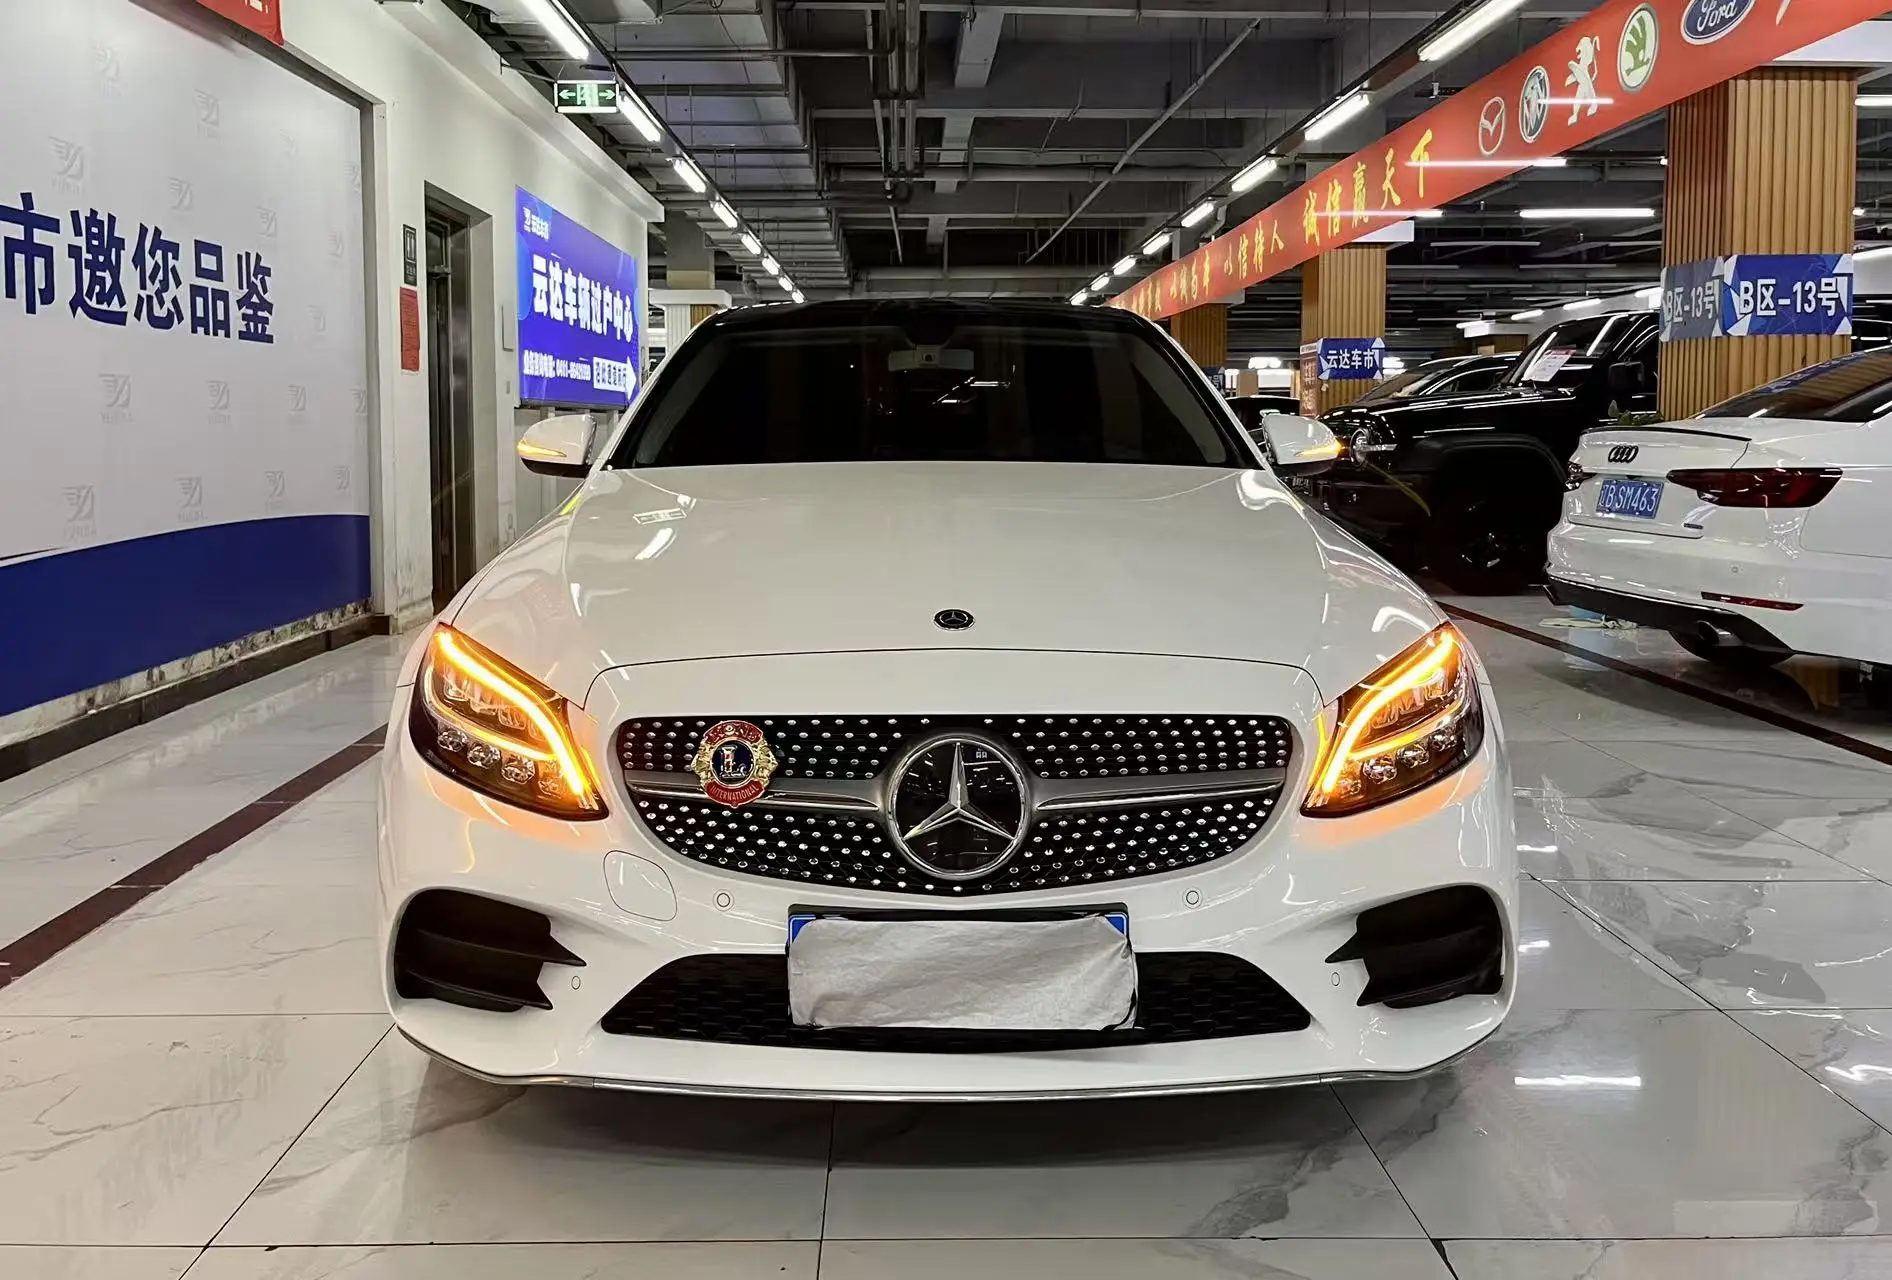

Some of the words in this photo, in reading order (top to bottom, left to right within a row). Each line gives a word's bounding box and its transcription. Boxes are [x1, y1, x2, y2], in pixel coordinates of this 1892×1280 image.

[1697, 0, 1737, 32] Ford
[1303, 128, 1433, 246] 诚信赢天下
[0, 192, 275, 345] 市邀您品鉴
[533, 254, 634, 343] 云达车辆过户中心
[1665, 282, 1716, 323] B区-13号
[1739, 278, 1839, 318] B区-13号
[1326, 348, 1374, 370] 云达车市
[710, 784, 759, 801] INTERNATIONAL
